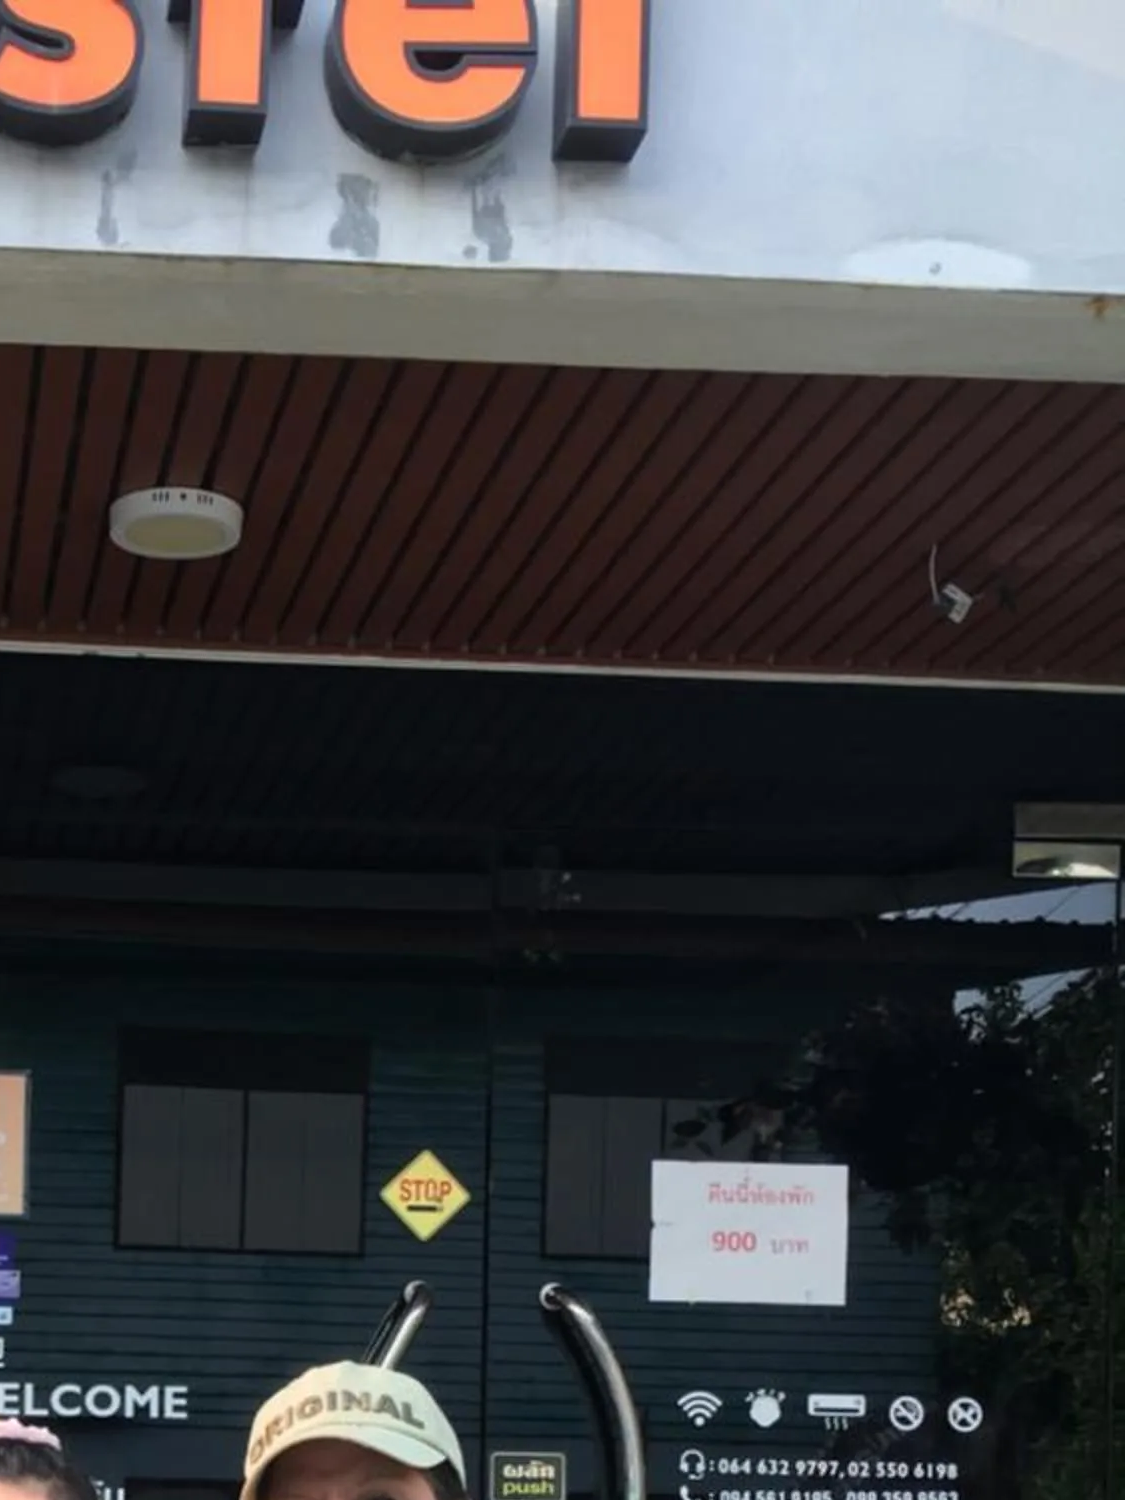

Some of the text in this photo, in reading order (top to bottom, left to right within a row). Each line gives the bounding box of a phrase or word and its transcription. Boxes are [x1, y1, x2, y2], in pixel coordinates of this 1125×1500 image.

[399, 1178, 452, 1202] STOP
[711, 1231, 757, 1252] 900
[249, 1389, 425, 1465] ORIGINAL
[718, 1457, 752, 1475] 064
[756, 1459, 790, 1476] 632
[875, 1461, 909, 1478] 550
[913, 1463, 959, 1480] 6198
[502, 1480, 555, 1497] push
